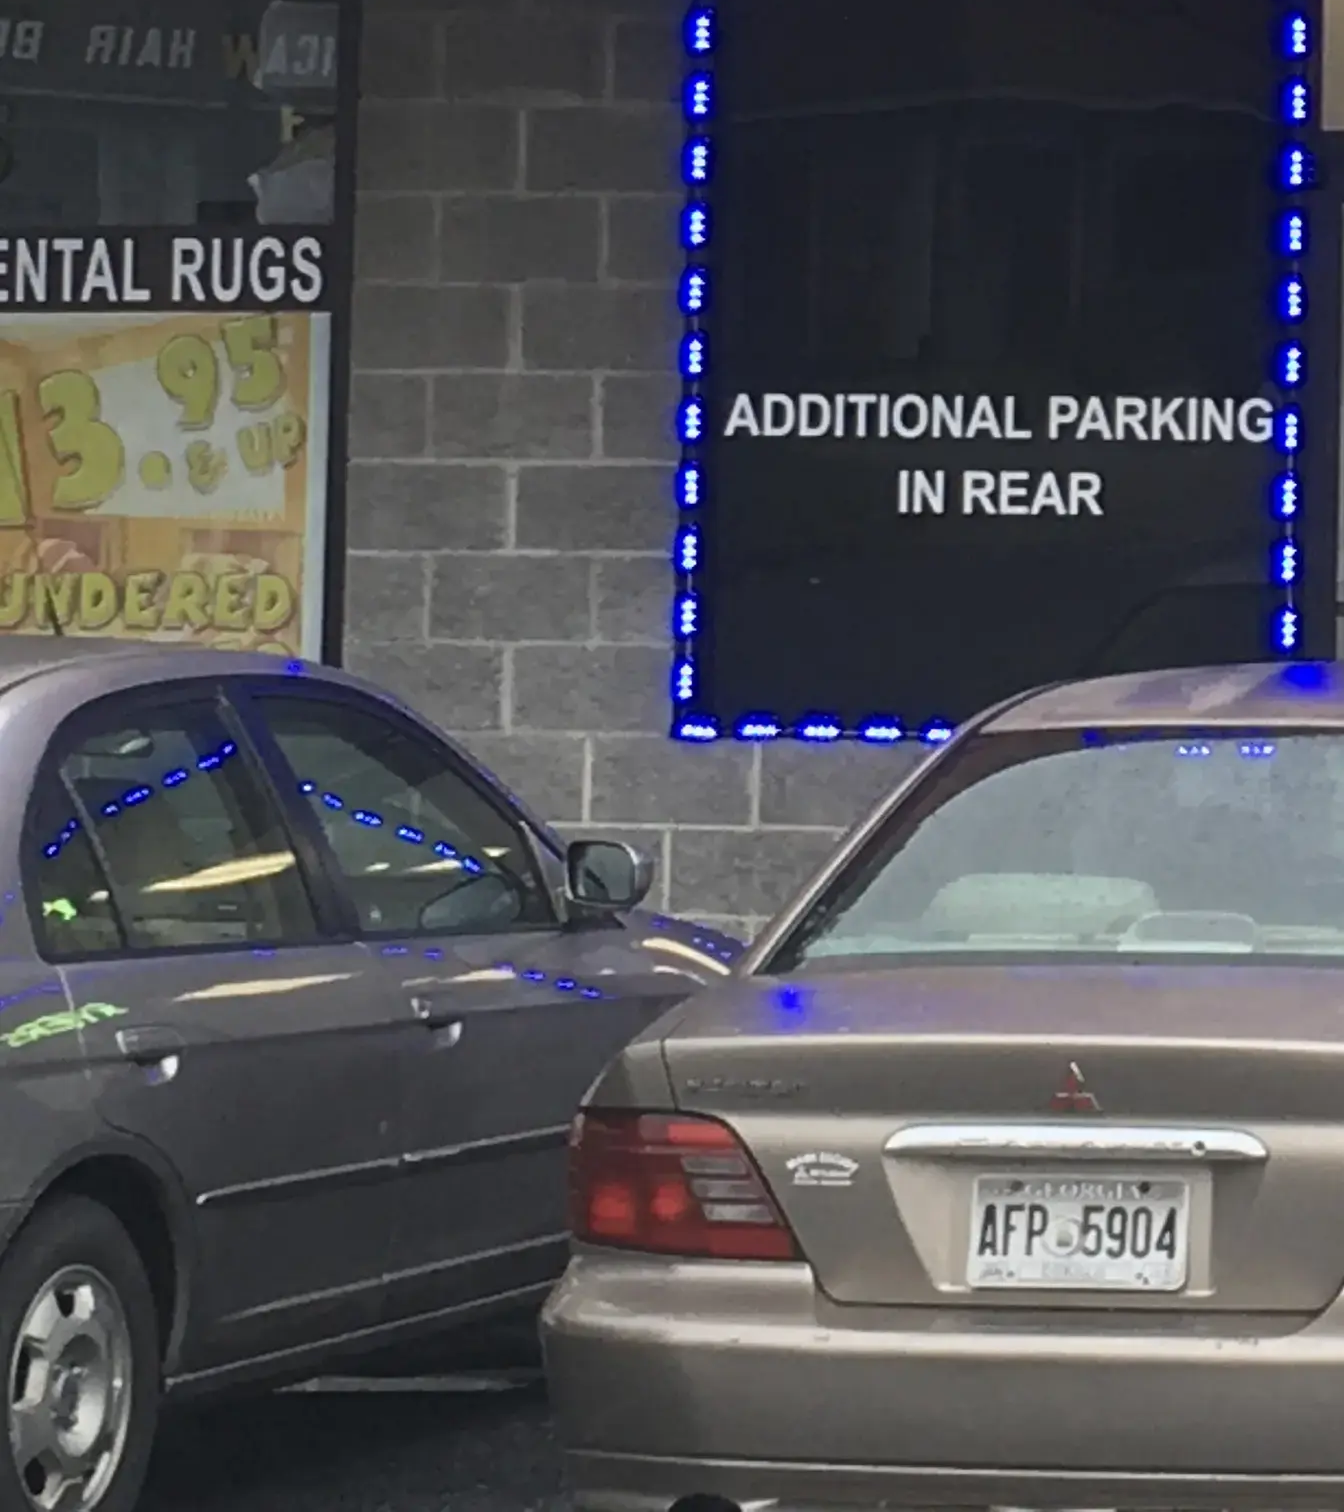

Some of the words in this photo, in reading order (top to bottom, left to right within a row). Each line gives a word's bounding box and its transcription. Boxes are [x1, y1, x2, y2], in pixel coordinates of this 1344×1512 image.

[172, 238, 323, 303] RUGS
[236, 415, 306, 477] UP
[724, 393, 1031, 439] ADDITIONAL
[1048, 397, 1275, 442] PARKING
[898, 470, 945, 514] IN
[962, 471, 1104, 515] REAR
[977, 1203, 1048, 1257] AFP
[1082, 1204, 1177, 1260] 5904
